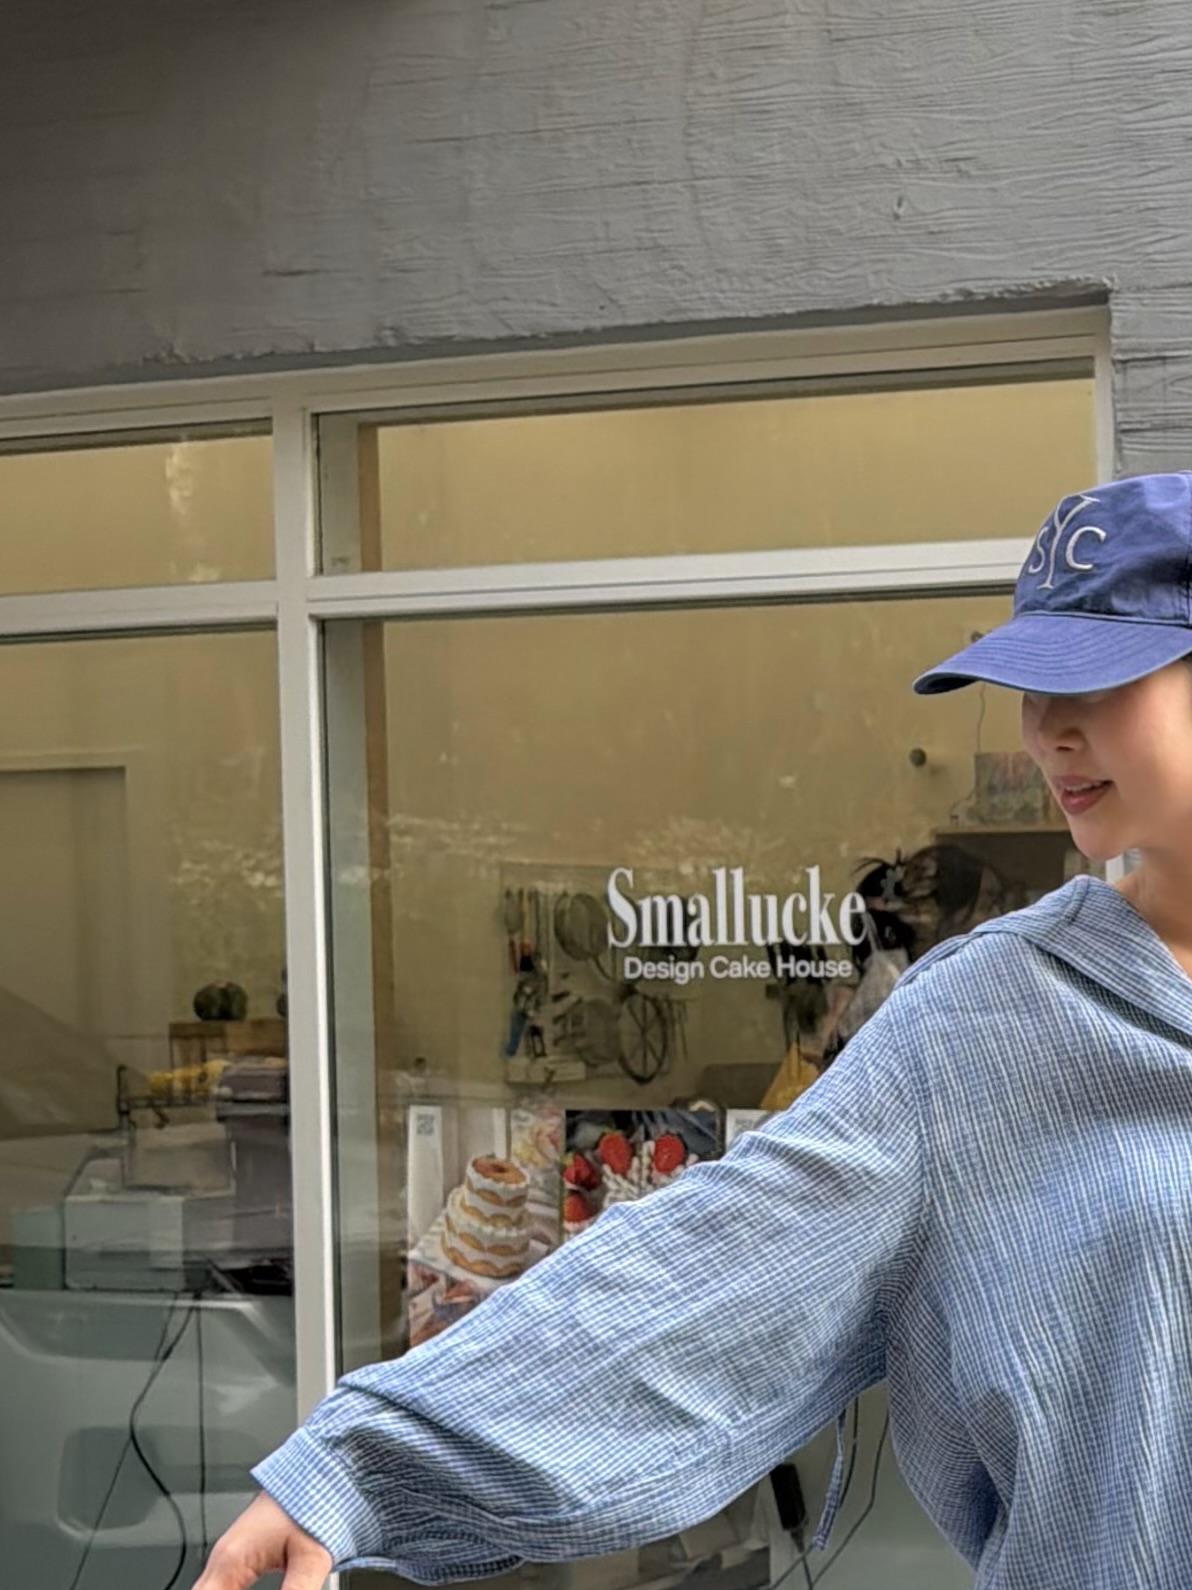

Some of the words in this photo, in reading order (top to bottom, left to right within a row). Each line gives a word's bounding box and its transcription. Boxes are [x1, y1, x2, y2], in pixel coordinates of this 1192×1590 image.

[607, 864, 869, 949] Smallucke
[624, 955, 705, 985] Design
[710, 954, 771, 979] Cake
[776, 954, 853, 978] House
